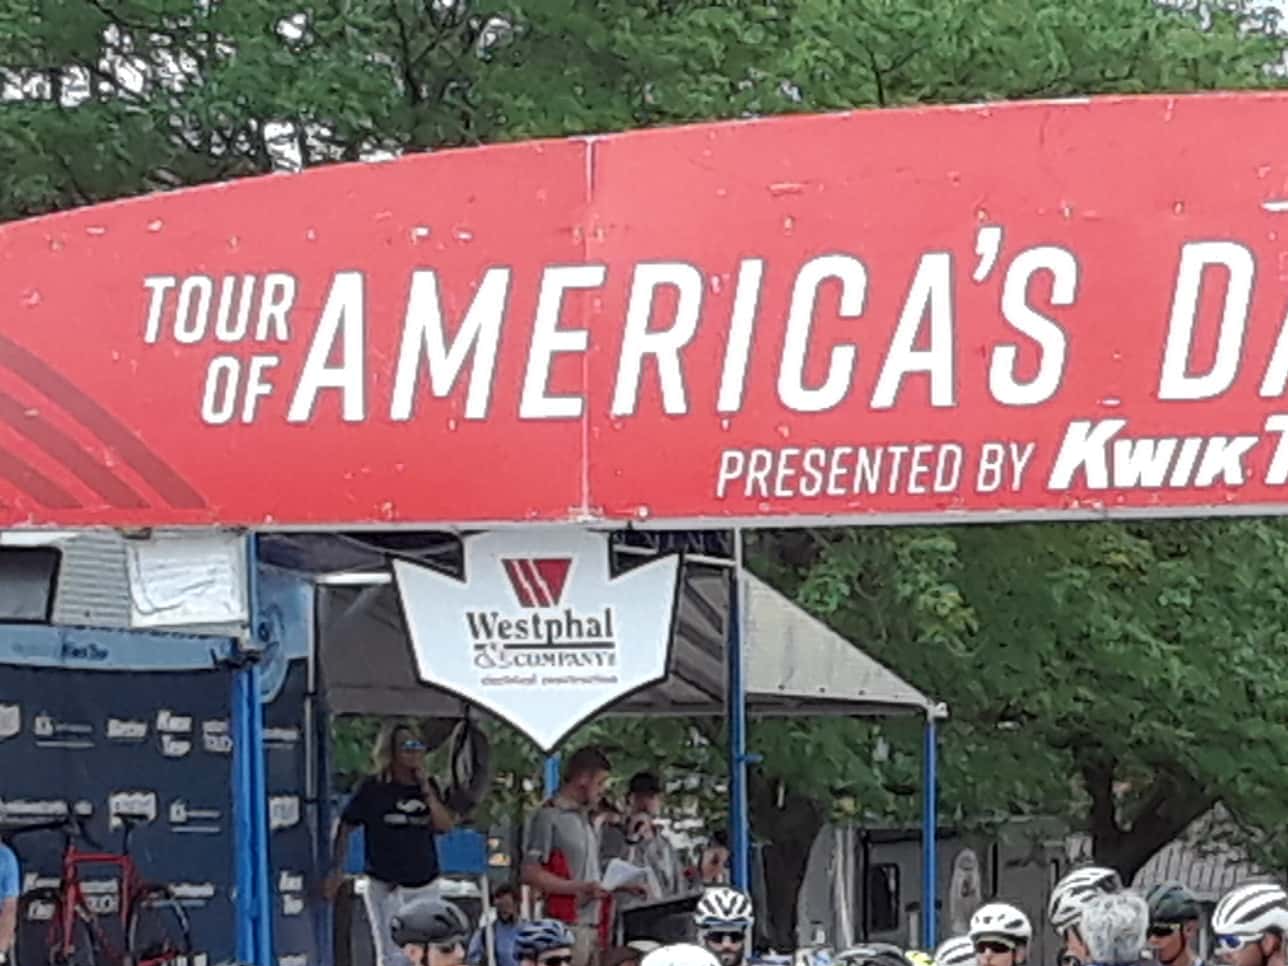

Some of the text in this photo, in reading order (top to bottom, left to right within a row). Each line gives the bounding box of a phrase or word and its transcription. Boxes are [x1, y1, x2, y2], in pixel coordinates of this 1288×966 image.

[143, 273, 299, 344] TOUR
[287, 224, 1079, 423] AMERICA'S
[200, 354, 279, 425] OF
[716, 442, 962, 498] PRESENTED
[974, 441, 1034, 492] BY
[466, 607, 615, 644] Westphal
